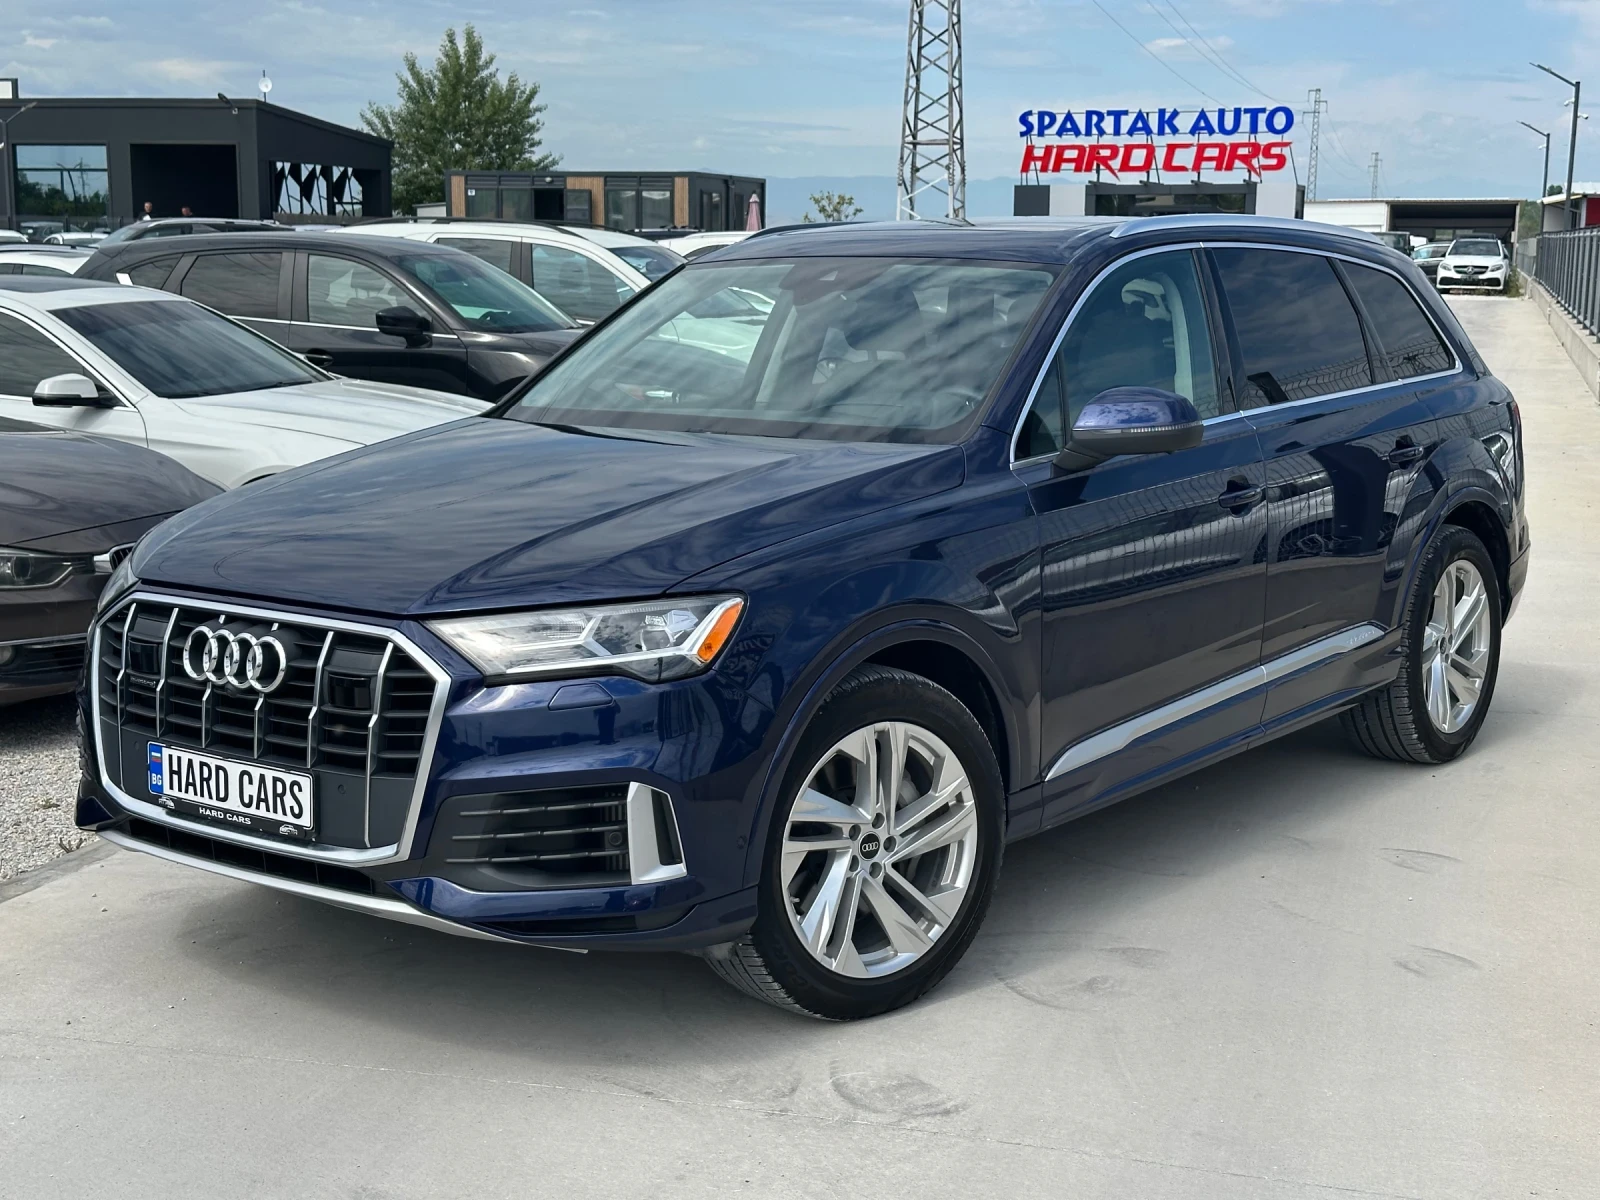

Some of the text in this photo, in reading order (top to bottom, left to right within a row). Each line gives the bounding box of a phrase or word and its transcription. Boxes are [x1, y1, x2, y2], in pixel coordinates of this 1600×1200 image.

[1018, 106, 1294, 138] SPARTAK AUTO
[1020, 141, 1293, 181] HARD CARS
[151, 773, 162, 786] BG
[168, 753, 304, 820] HARD CARS
[199, 806, 251, 825] HARD CARS
